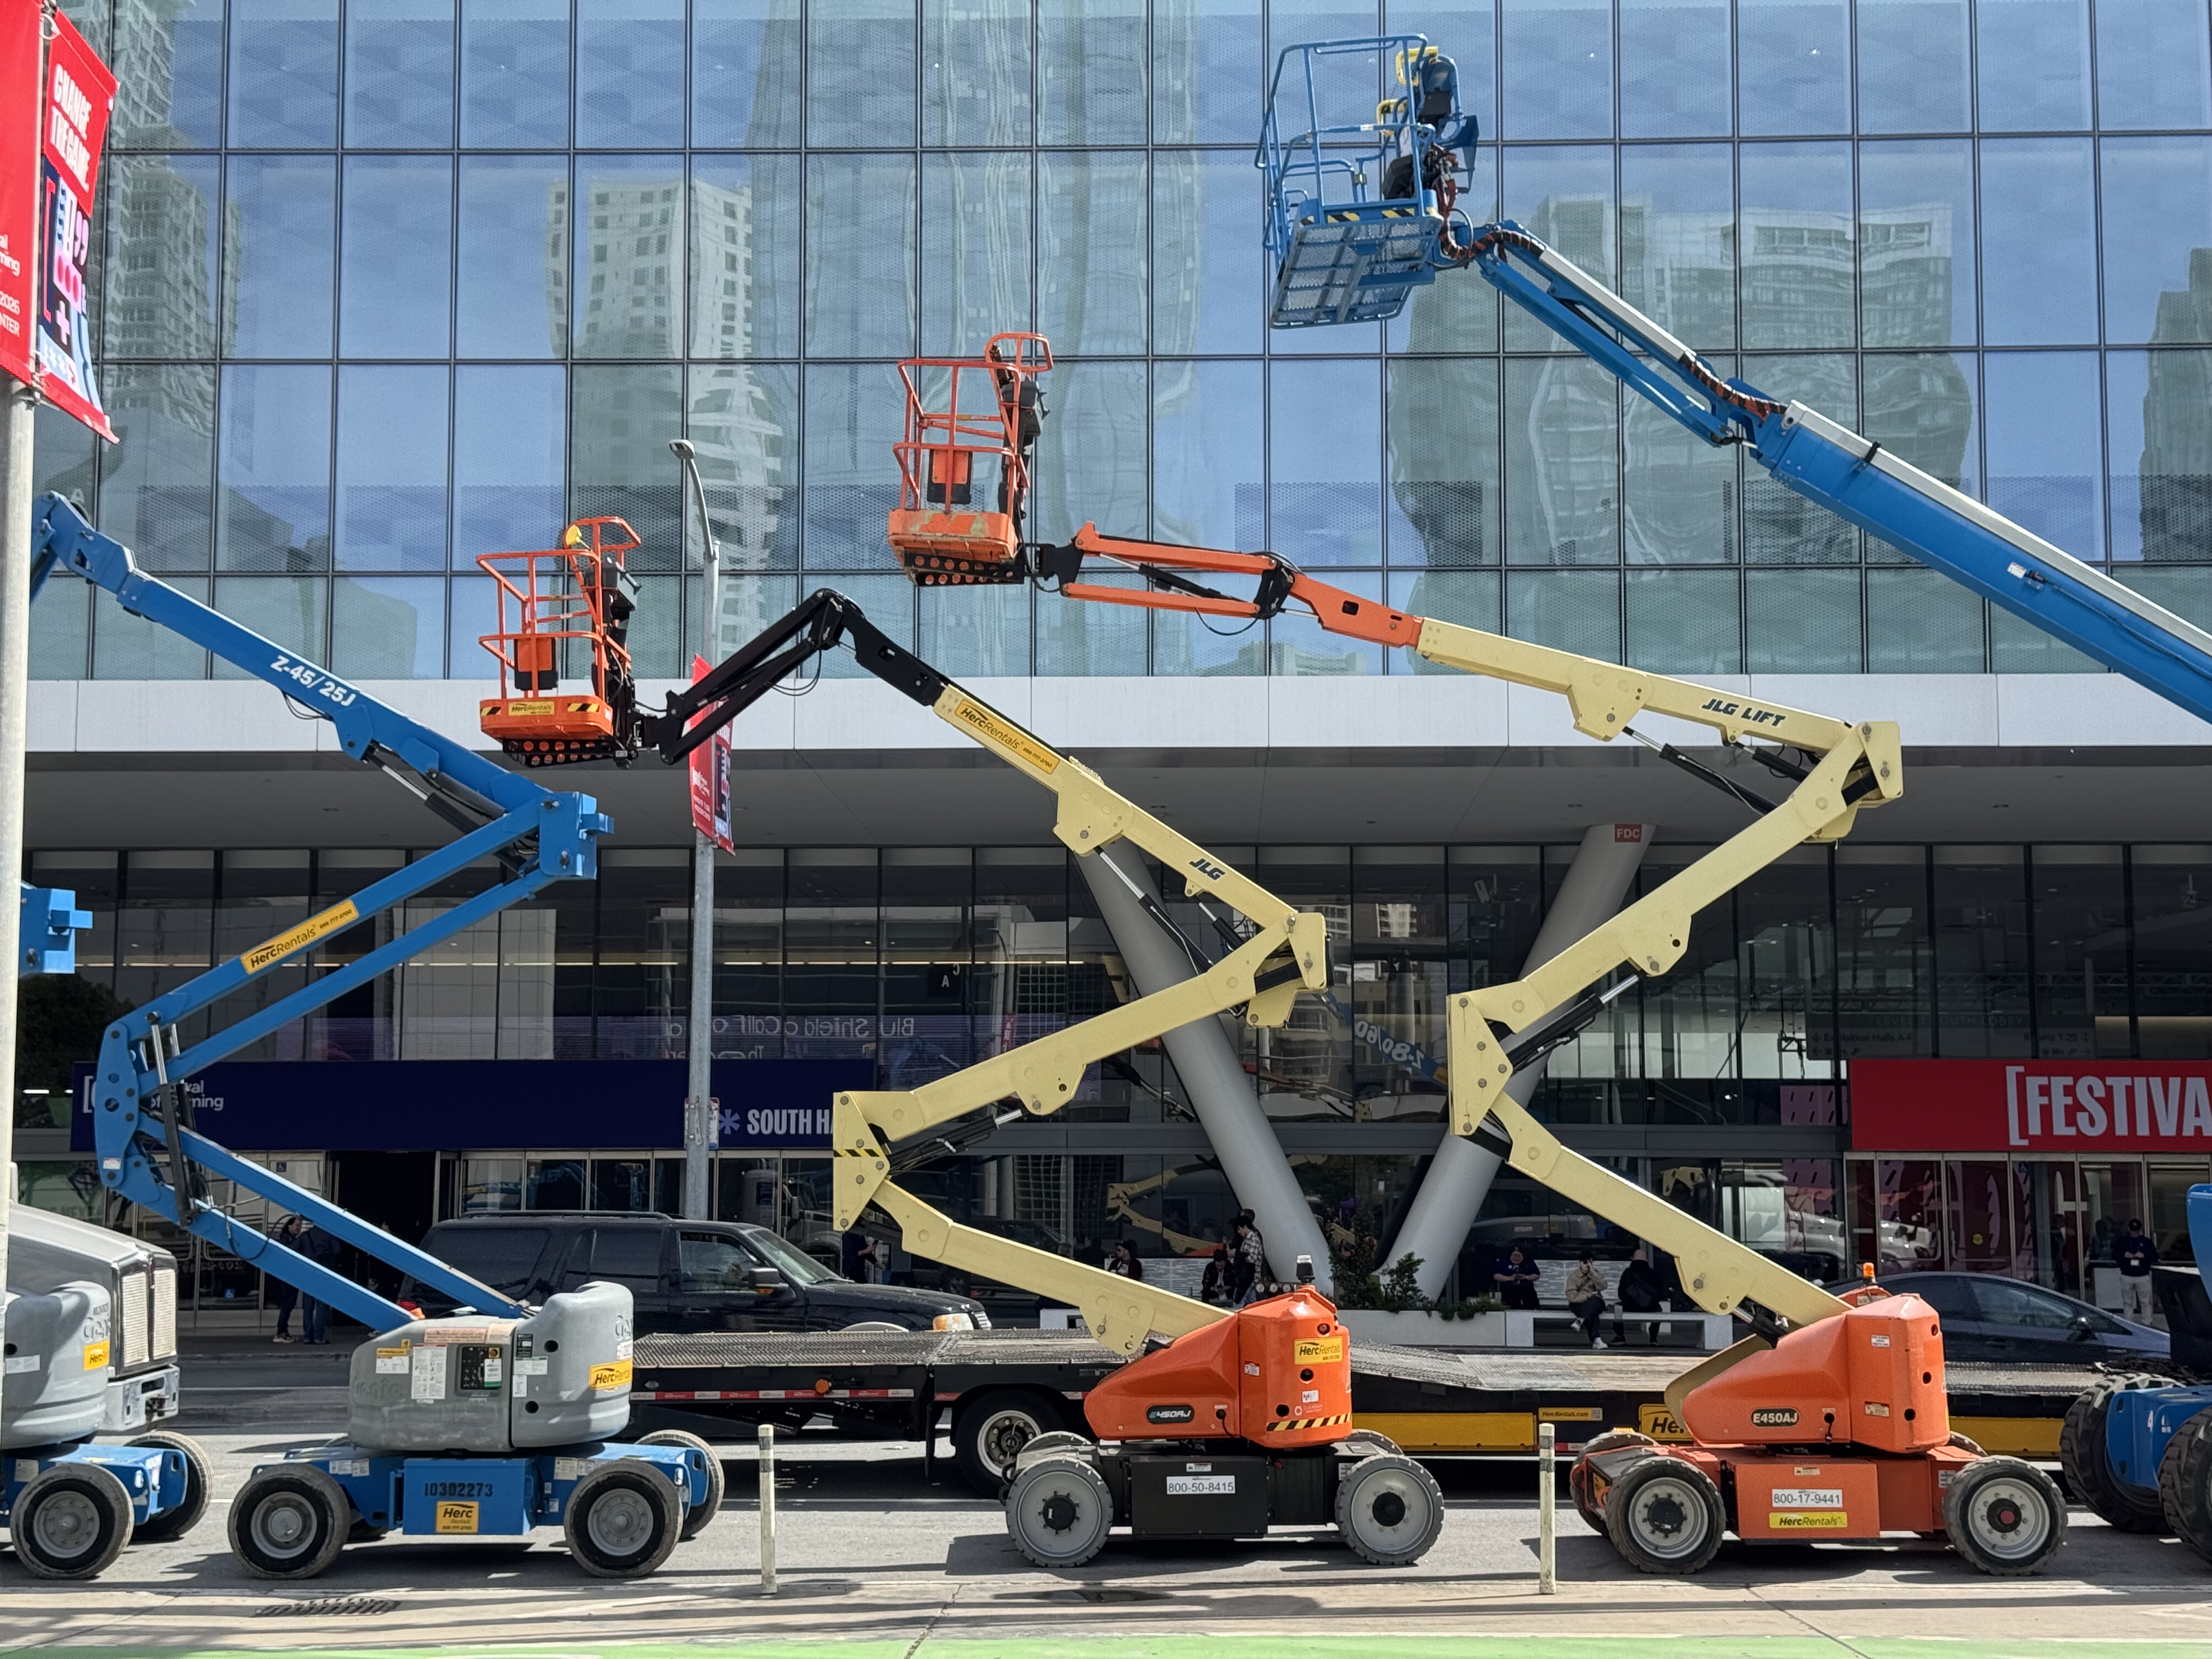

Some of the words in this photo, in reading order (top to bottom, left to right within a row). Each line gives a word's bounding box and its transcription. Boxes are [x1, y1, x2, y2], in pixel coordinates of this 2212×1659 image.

[53, 63, 92, 141] CHANGE
[0, 251, 20, 277] ming
[0, 312, 20, 337] NTER
[1702, 698, 1739, 715] JLG
[1741, 707, 1786, 727] LIFT
[960, 707, 1020, 749] HercRentals
[1616, 828, 1640, 838] FDC
[1188, 858, 1226, 881] JLG
[250, 926, 317, 968] HercRentals
[1939, 1016, 1976, 1026] OUTH
[1981, 1016, 2023, 1026] LOBBY
[1824, 1032, 1870, 1042] Exibition
[747, 1109, 812, 1135] SOUTH
[1149, 1409, 1192, 1419] E450AJ
[1753, 1412, 1798, 1424] E450AJ
[1650, 1417, 1684, 1434] He
[425, 1482, 493, 1497] 10302273
[1169, 1482, 1234, 1493] 800-50-8415
[1774, 1493, 1840, 1504] 800-17-9441
[443, 1507, 473, 1519] Herc
[1779, 1516, 1838, 1526] HercRentals
